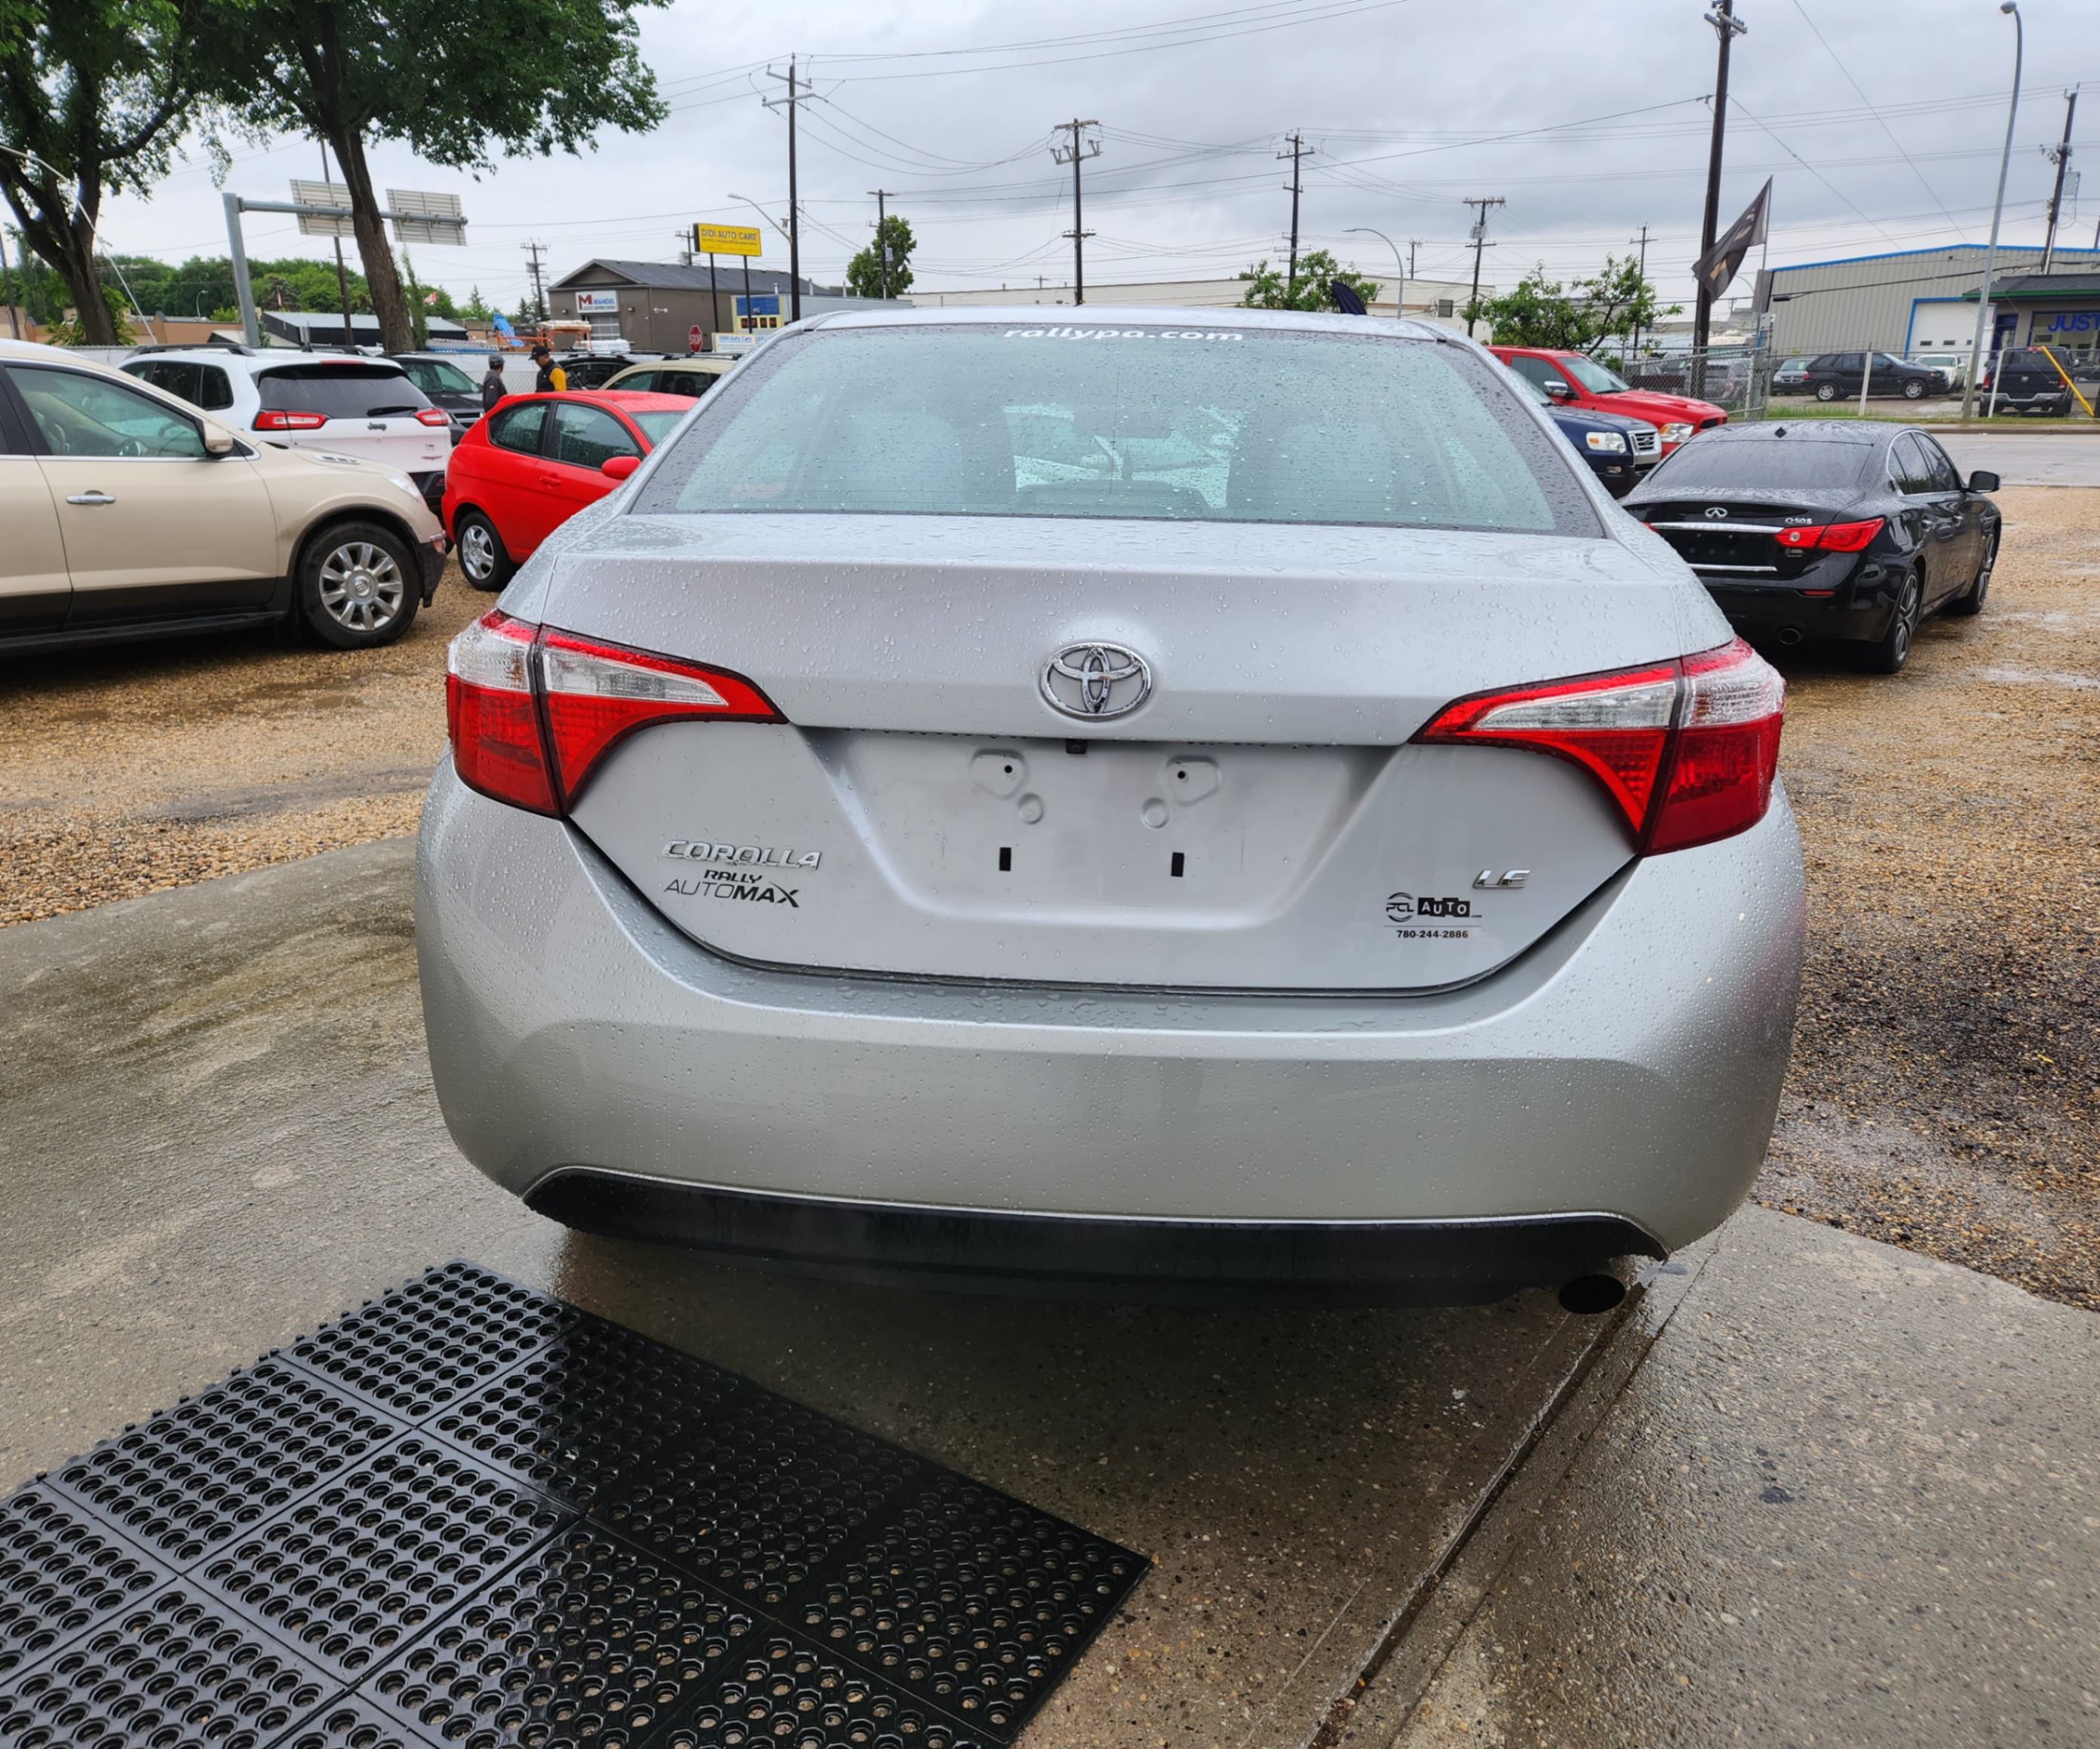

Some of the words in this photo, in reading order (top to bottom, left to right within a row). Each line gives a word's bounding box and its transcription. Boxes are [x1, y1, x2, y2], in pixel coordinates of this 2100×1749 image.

[718, 230, 736, 239] AUTO
[738, 232, 757, 241] CARE
[689, 334, 702, 345] STOP
[1004, 327, 1243, 341] rallypa.com
[662, 839, 821, 870] COROLLA
[704, 870, 763, 884] RALLY
[1472, 870, 1530, 890] LE
[664, 879, 800, 908] AUTOMAX
[1386, 902, 1414, 913] PCL
[1421, 901, 1467, 915] AUTO
[1396, 930, 1469, 938] 780-244-2886
